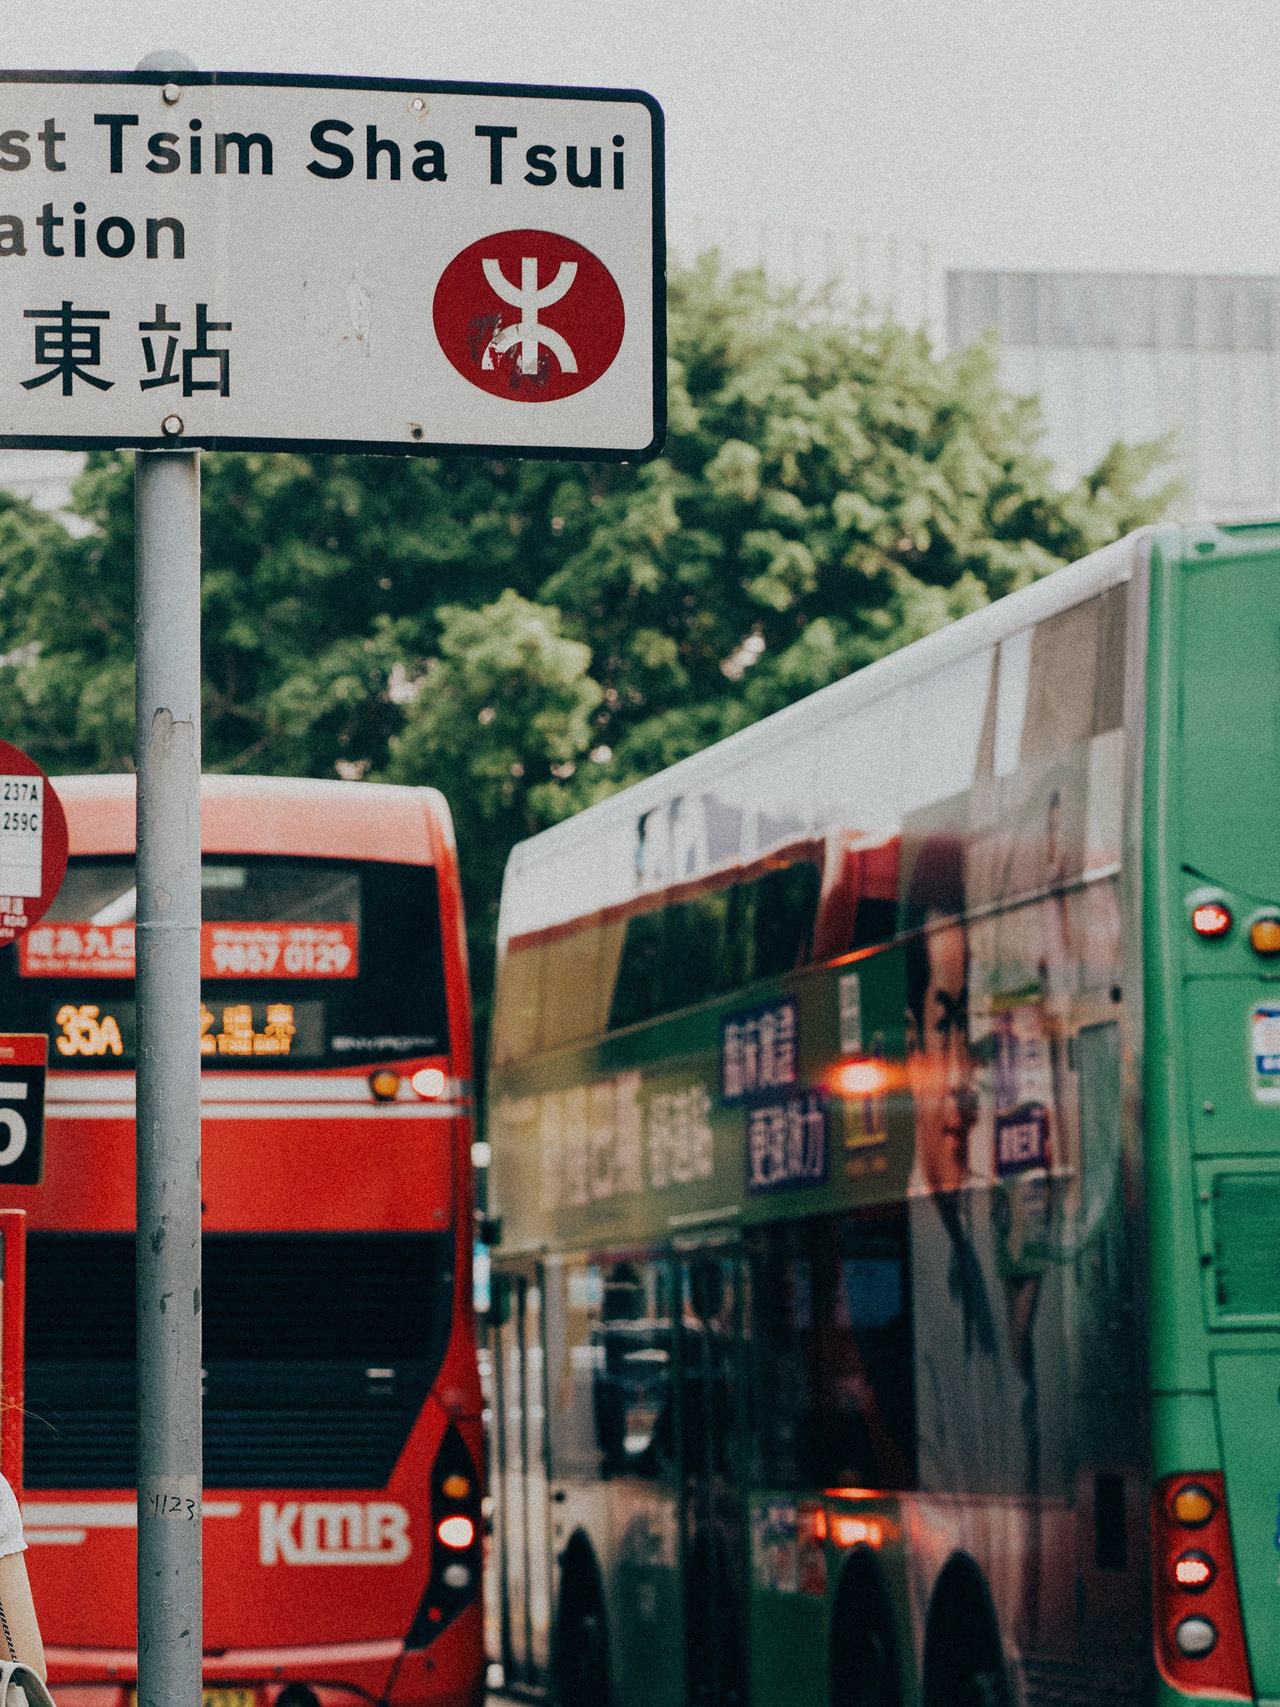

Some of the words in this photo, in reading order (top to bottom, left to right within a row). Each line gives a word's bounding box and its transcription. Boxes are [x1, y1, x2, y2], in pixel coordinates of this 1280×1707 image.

[93, 113, 274, 176] Tsim
[306, 119, 448, 182] Sha
[474, 124, 625, 191] Tsui
[3, 782, 39, 802] 237A
[2, 811, 39, 832] 259C
[56, 1005, 123, 1056] 35A
[258, 1501, 411, 1566] KMB
